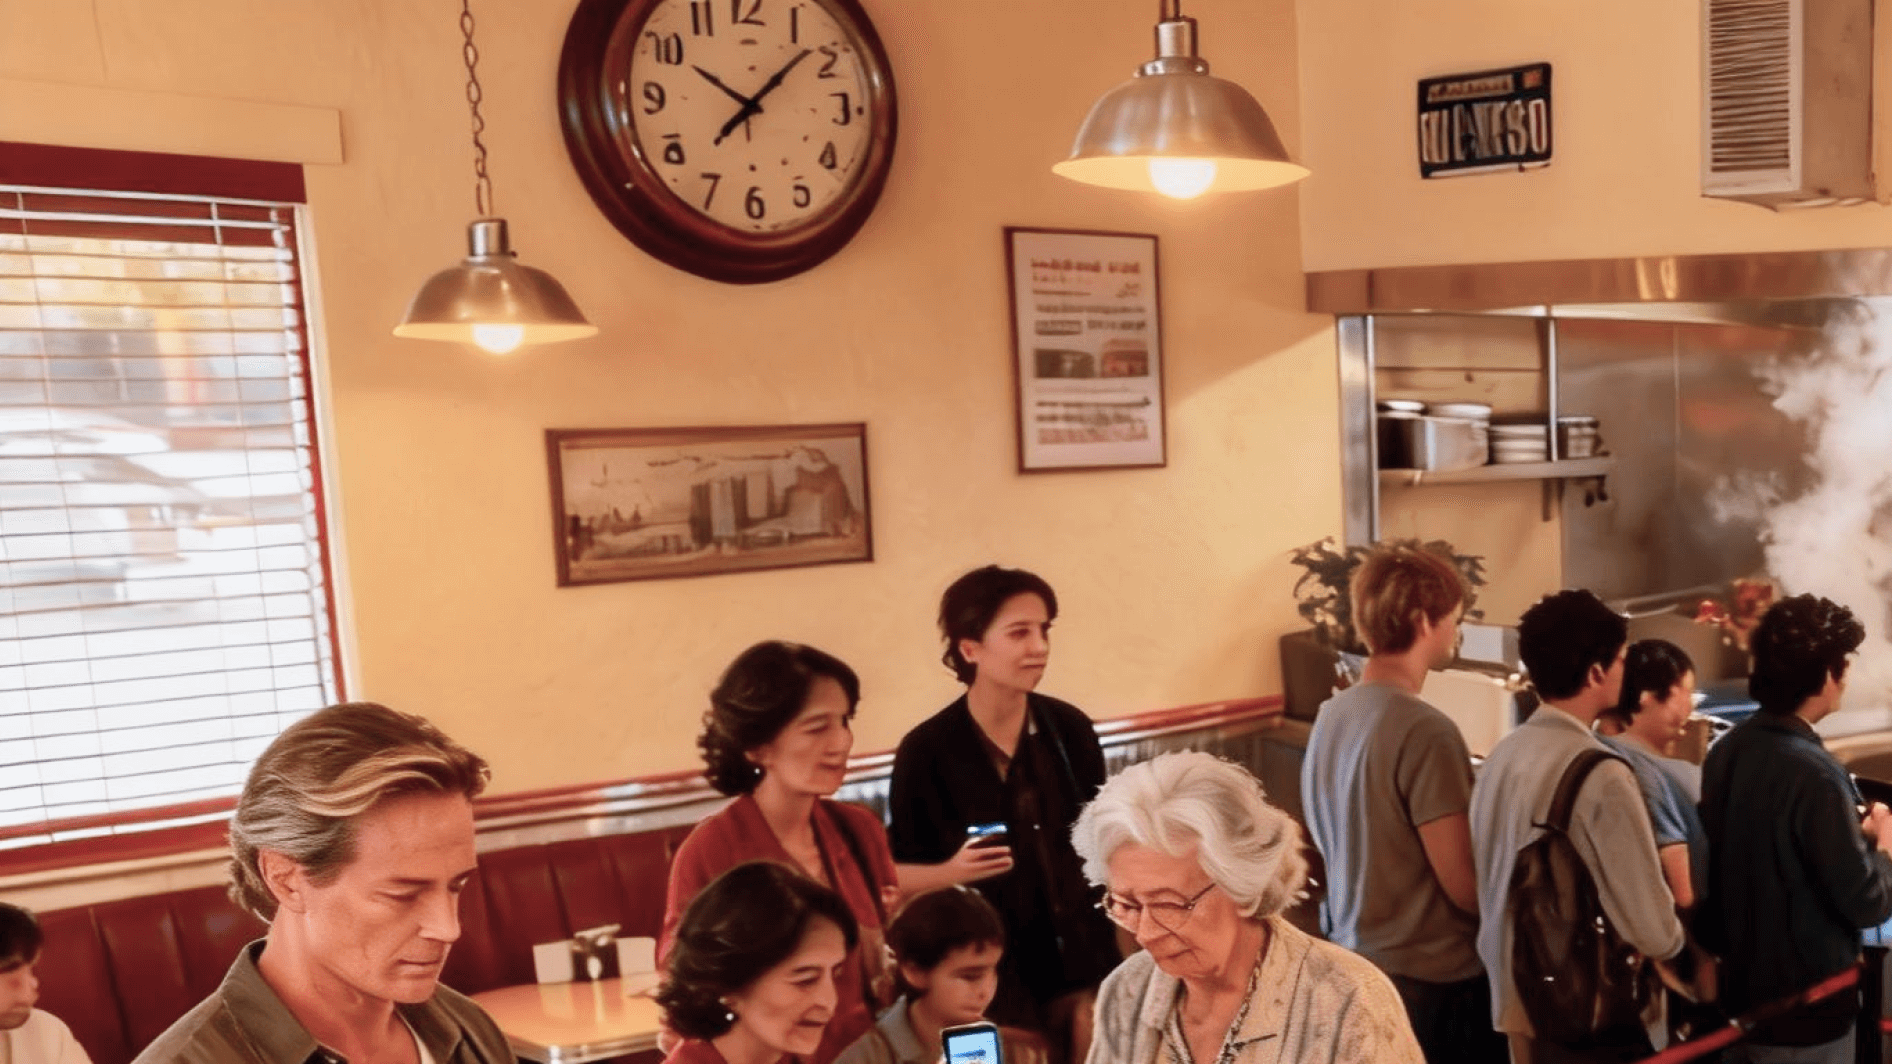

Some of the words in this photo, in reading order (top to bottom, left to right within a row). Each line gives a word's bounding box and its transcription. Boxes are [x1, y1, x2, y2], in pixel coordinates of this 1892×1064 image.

[643, 81, 666, 115] 9
[700, 172, 721, 211] 7
[744, 186, 765, 220] 6
